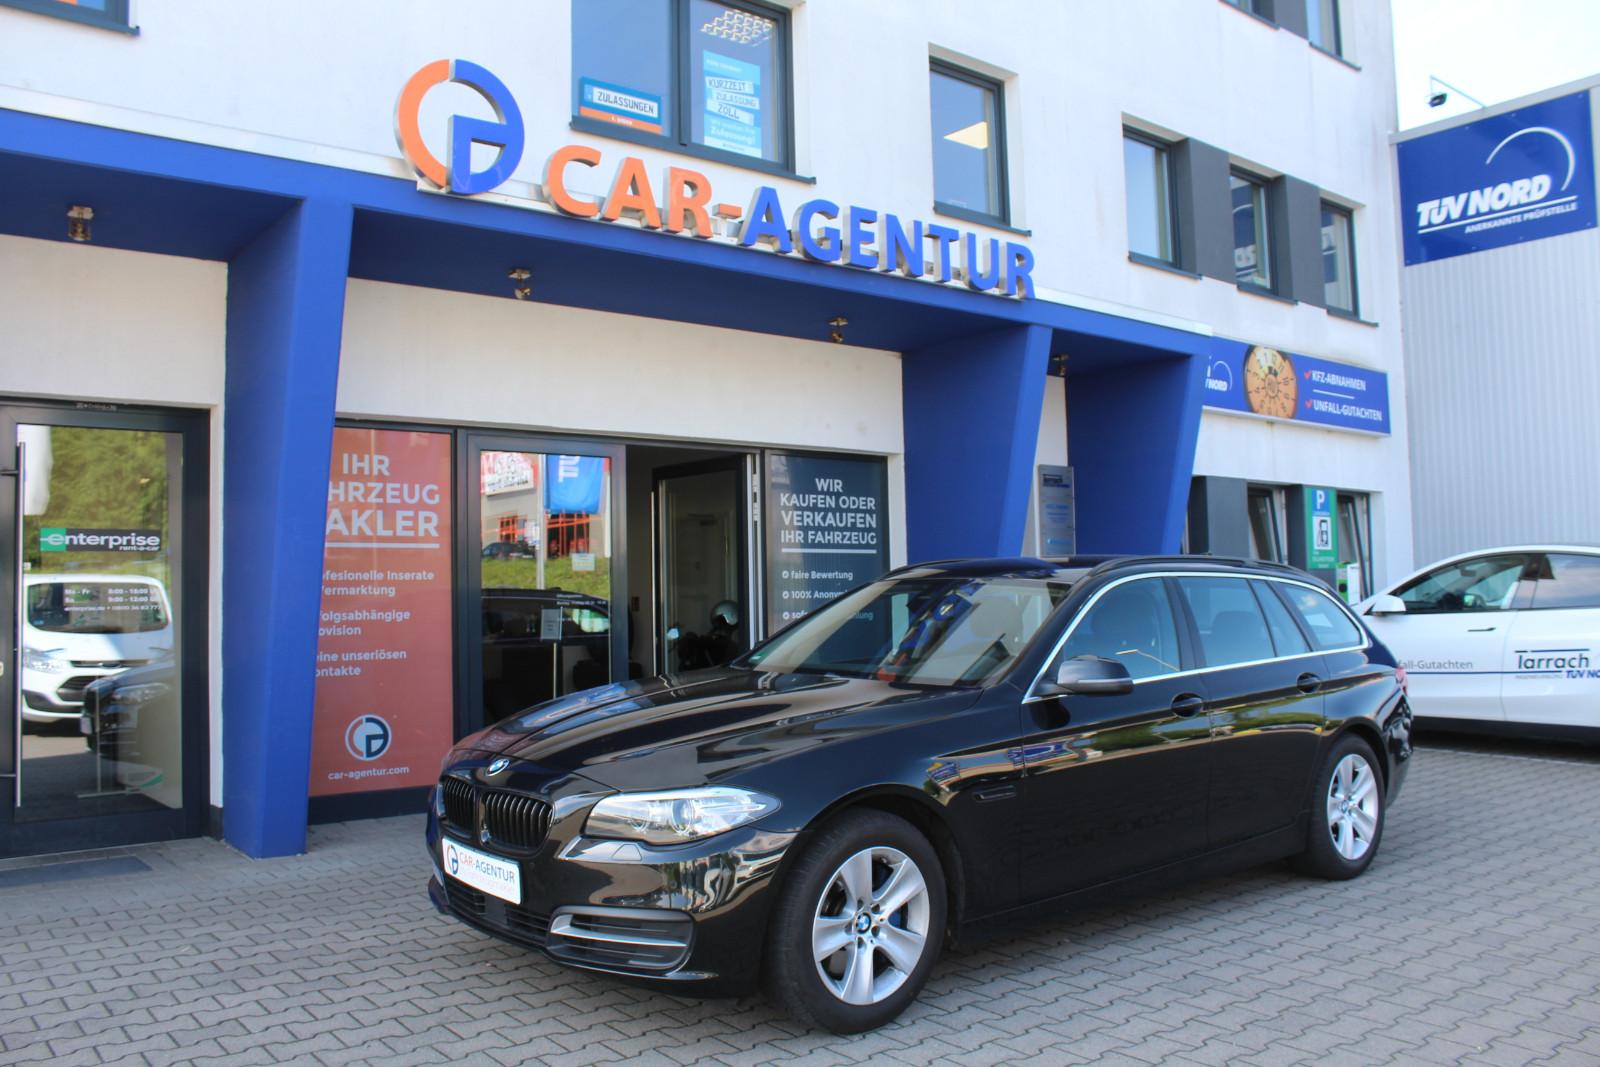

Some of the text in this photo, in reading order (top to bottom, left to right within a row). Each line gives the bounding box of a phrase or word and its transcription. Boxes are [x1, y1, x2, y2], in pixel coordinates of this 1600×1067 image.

[596, 91, 655, 114] ZULASSUNGEN
[717, 103, 740, 119] ZOLL
[1467, 174, 1552, 216] NORD
[543, 145, 1037, 299] CAR-AGENTUR
[1465, 202, 1578, 233] ANERKANNTE PRÜFSTELLE
[1312, 370, 1367, 392] KFZ-ABNAHMEN
[1313, 399, 1382, 421] UNFALL-GUTACHTEN
[342, 453, 391, 476] IHR
[815, 478, 843, 492] WIR
[780, 493, 876, 510] KAUFEN ODER
[1316, 489, 1325, 510] P
[781, 511, 877, 529] VERKAUFEN
[47, 533, 160, 549] enterprise
[781, 530, 877, 545] IHR FAHRZEUG
[323, 570, 435, 581] fesionelle Inserate
[791, 570, 853, 581] faire Bewertung
[321, 585, 396, 597] ermarktung
[791, 590, 812, 599] 100%
[317, 649, 407, 661] ine unseriösen
[328, 766, 410, 780] car-agentur.com
[459, 852, 516, 885] CAR-AGENTUR
